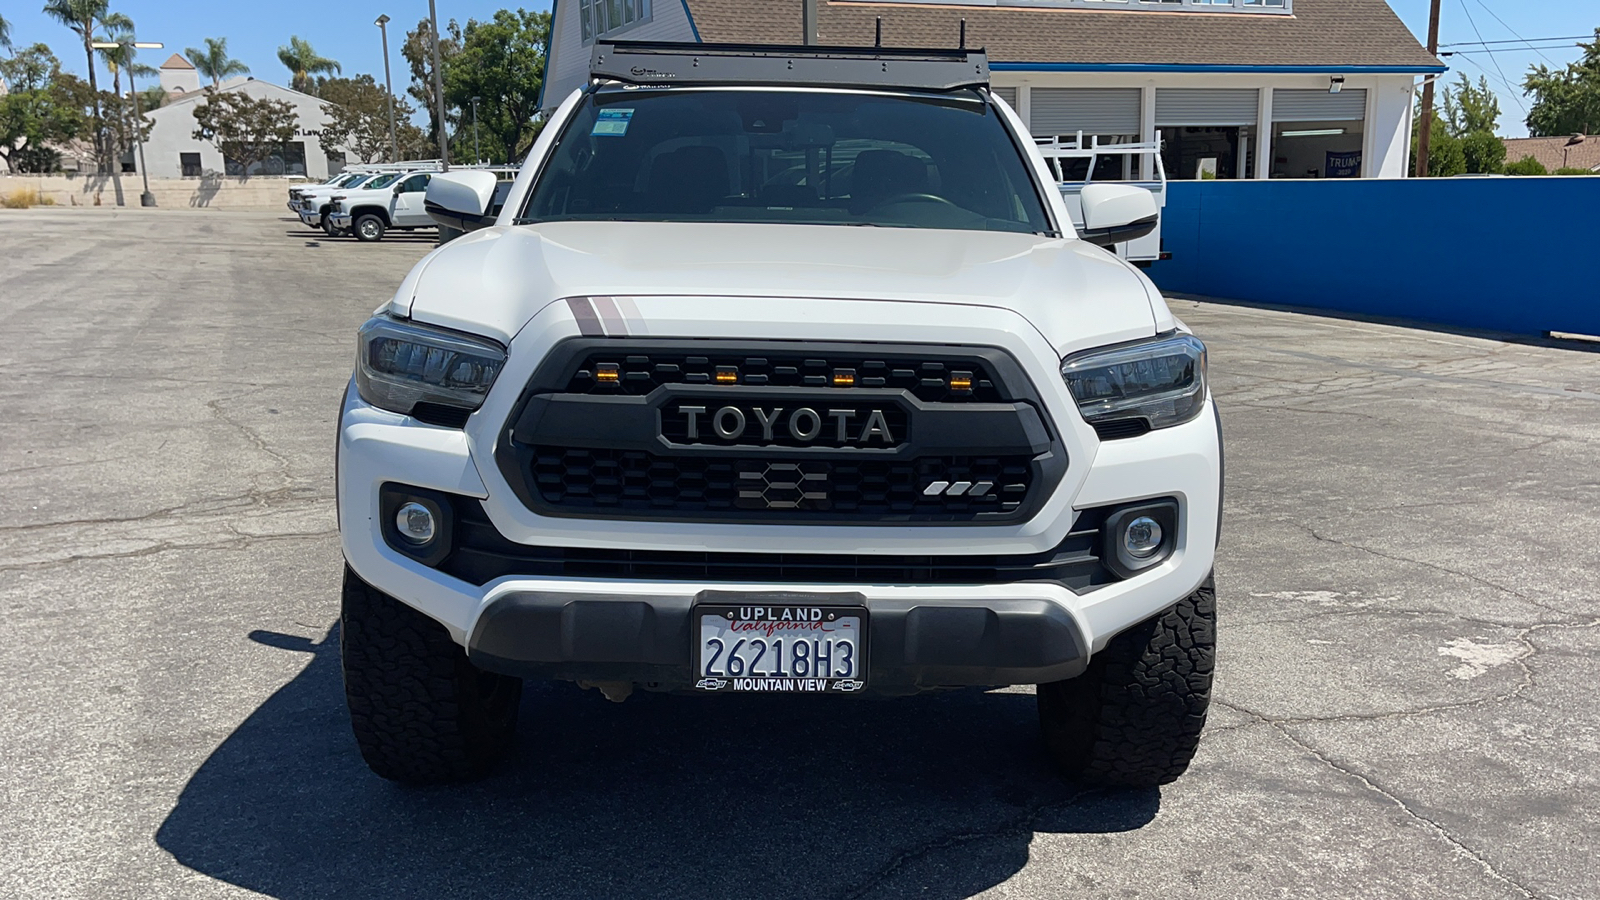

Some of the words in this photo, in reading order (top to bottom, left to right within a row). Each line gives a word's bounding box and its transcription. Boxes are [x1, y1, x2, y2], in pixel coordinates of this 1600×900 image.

[302, 128, 320, 136] Law
[322, 128, 350, 137] Grp
[1330, 156, 1361, 168] TRUMP
[678, 405, 894, 443] TOYOTA
[740, 607, 822, 621] UPLAND
[730, 620, 835, 637] California
[705, 638, 854, 678] 26218H3
[733, 679, 796, 691] MOUNTAIN
[797, 680, 827, 691] VIEW
